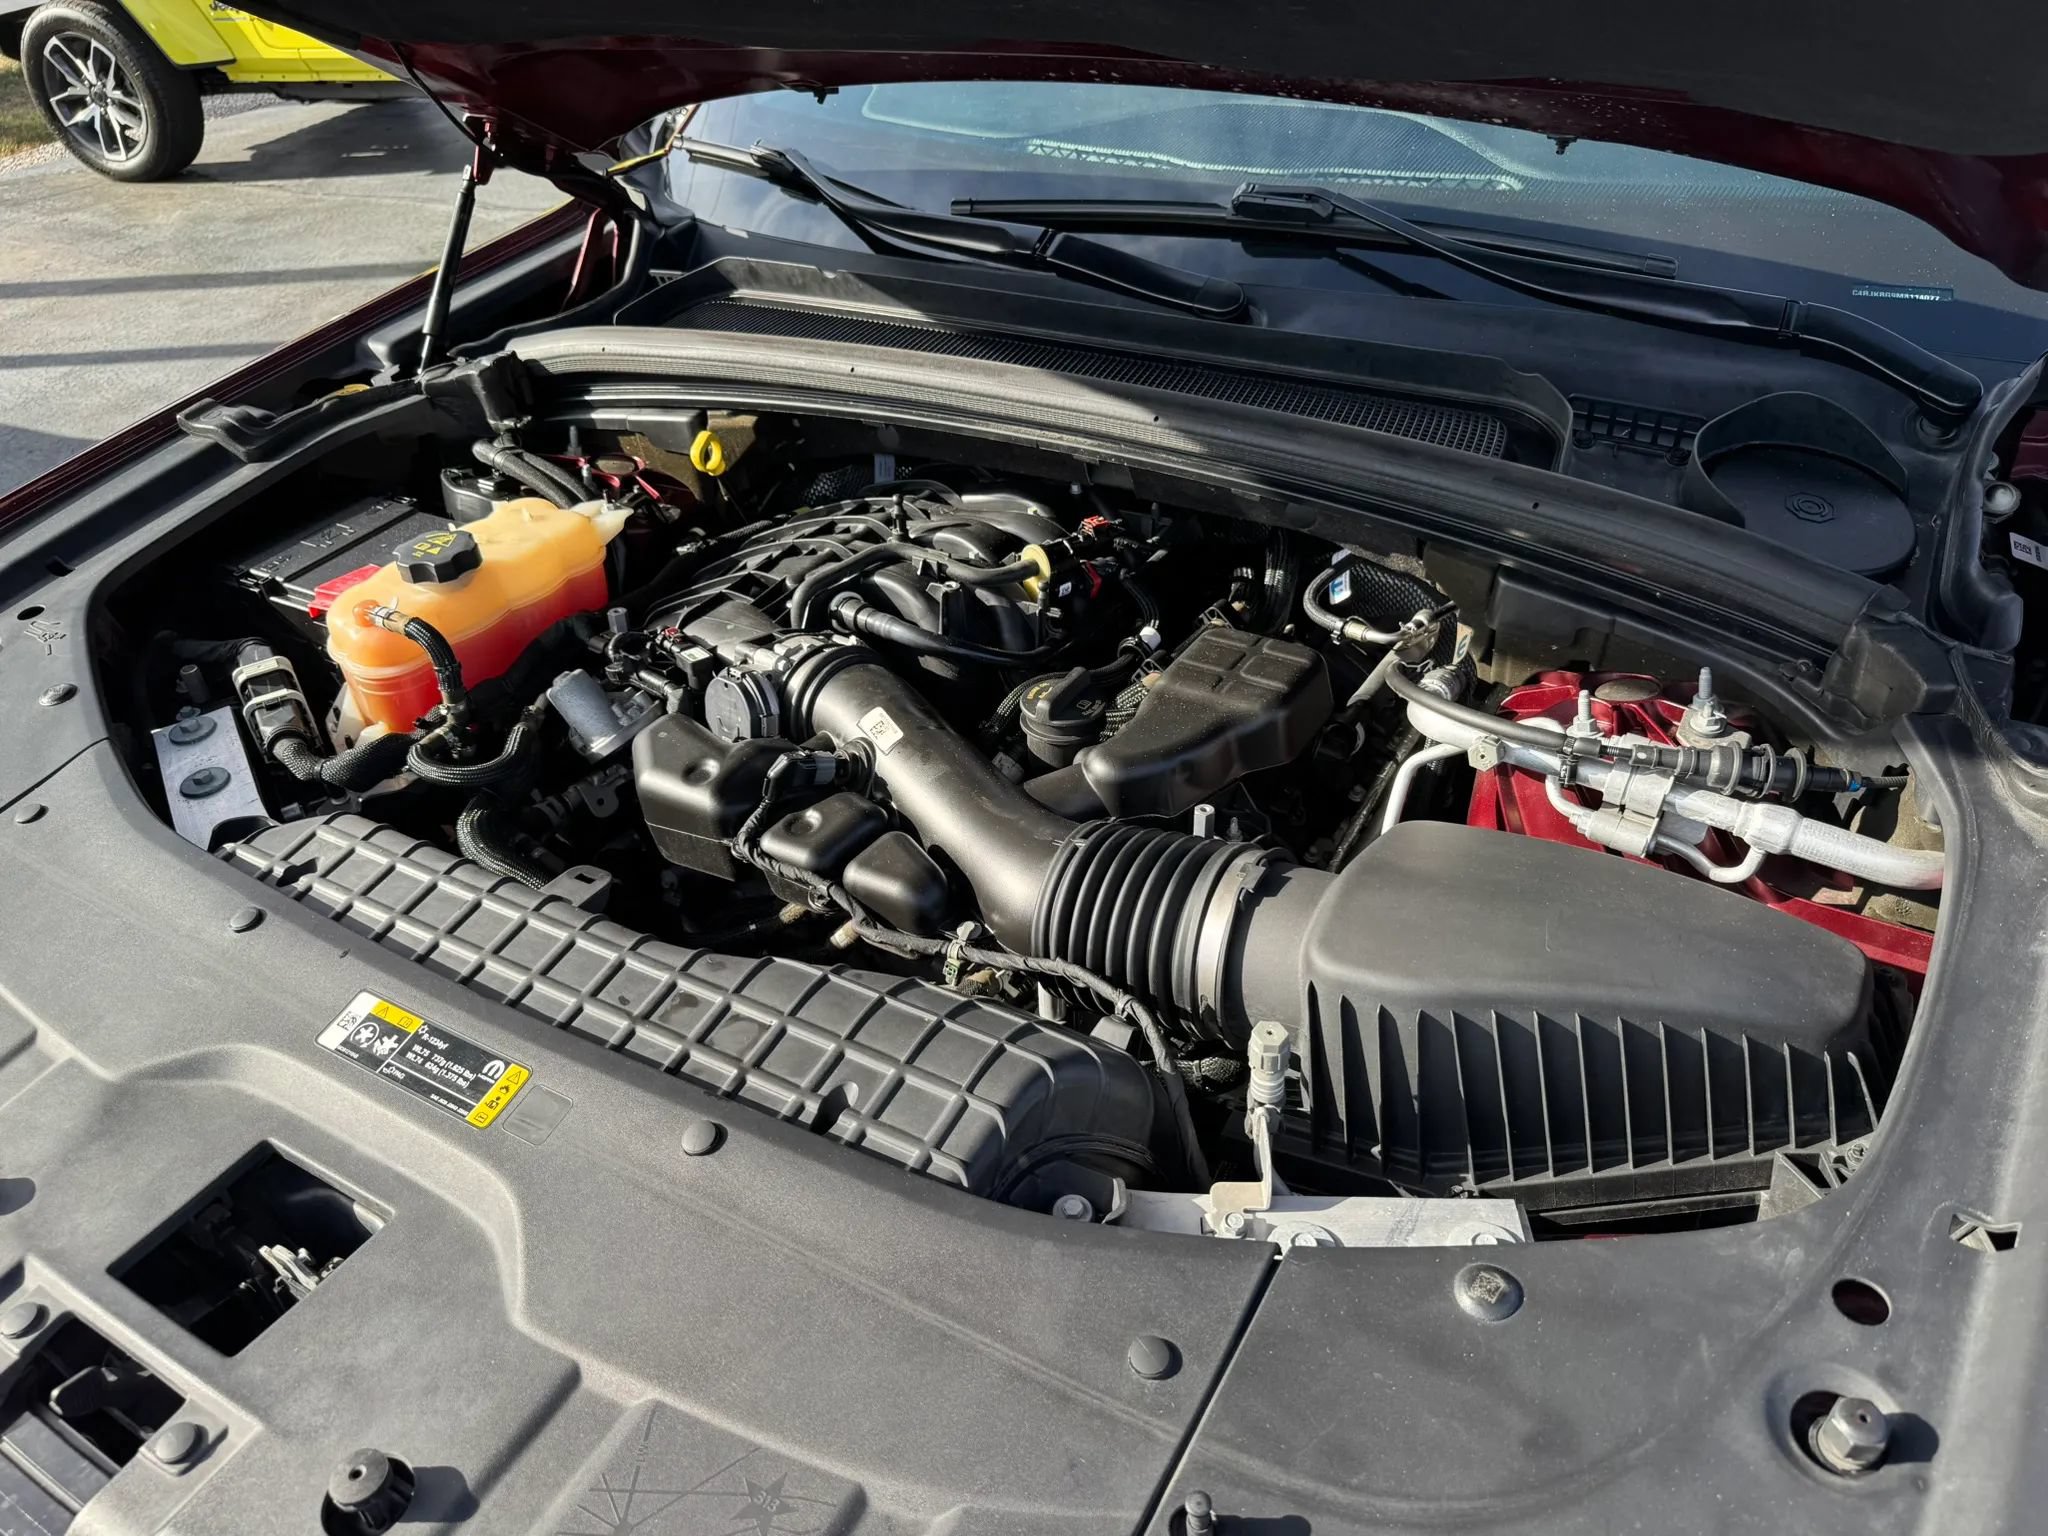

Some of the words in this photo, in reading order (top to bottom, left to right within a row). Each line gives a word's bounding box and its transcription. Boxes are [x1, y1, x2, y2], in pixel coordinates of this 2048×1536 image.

[421, 1034, 449, 1050] R-1234yf
[405, 1051, 424, 1065] WL74
[412, 1044, 430, 1057] WL75
[753, 1490, 780, 1512] 313
